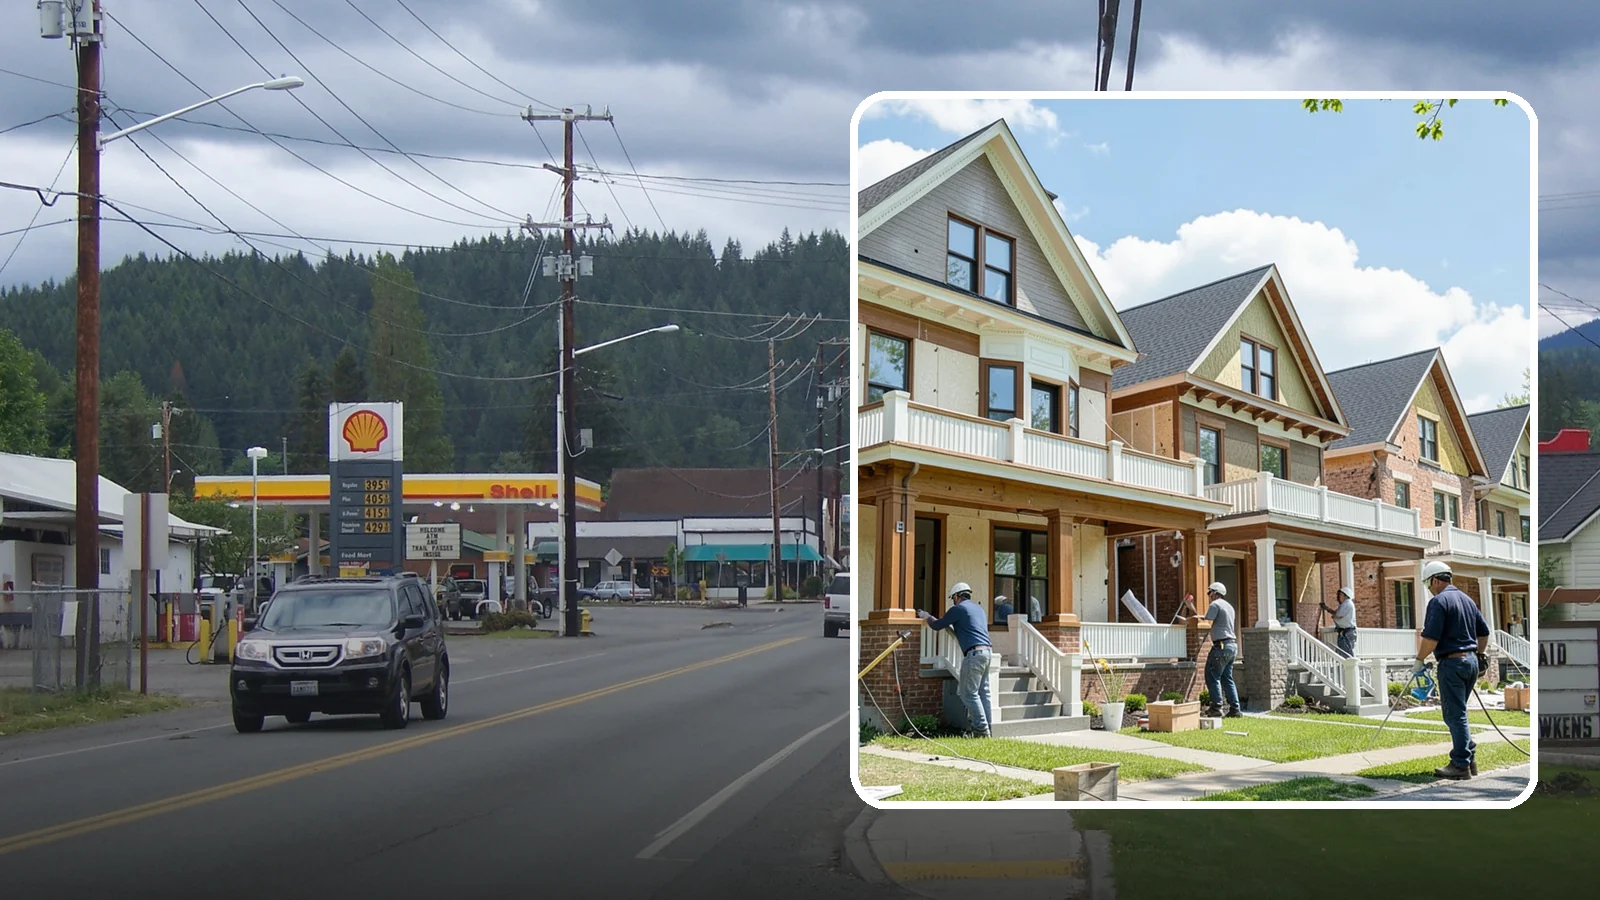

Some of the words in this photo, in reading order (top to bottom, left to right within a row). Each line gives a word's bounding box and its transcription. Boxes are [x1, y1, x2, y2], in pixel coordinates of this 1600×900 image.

[366, 480, 383, 490] 395
[490, 484, 547, 499] Shell
[366, 494, 383, 504] 405
[366, 508, 383, 518] 415
[366, 522, 383, 532] 429
